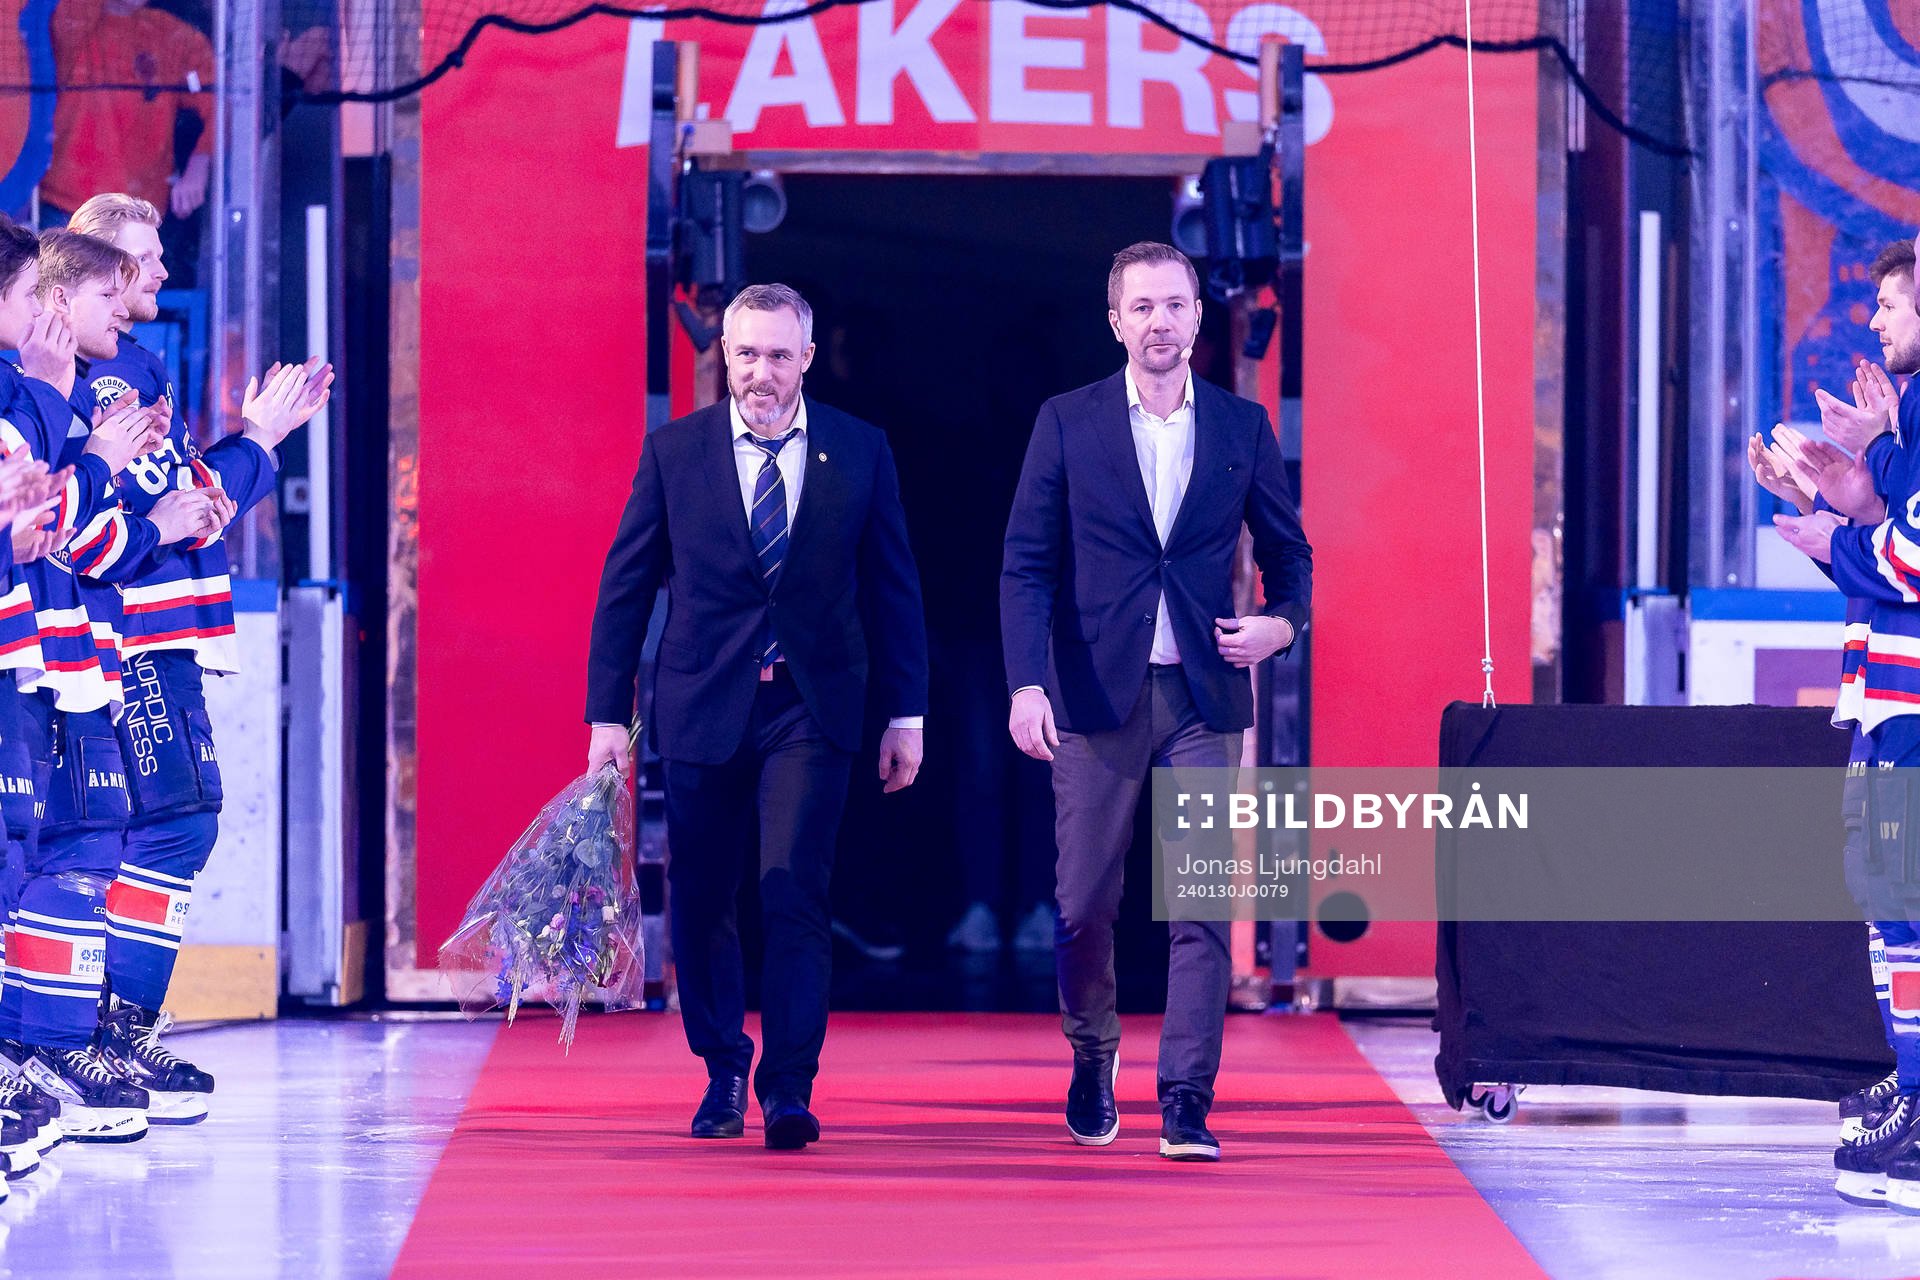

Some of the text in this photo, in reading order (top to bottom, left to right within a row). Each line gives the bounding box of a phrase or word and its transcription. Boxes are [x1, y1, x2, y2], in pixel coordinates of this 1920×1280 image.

[615, 0, 1335, 148] LAKERS
[134, 651, 174, 744] NORDIC
[115, 1117, 134, 1127] CCM
